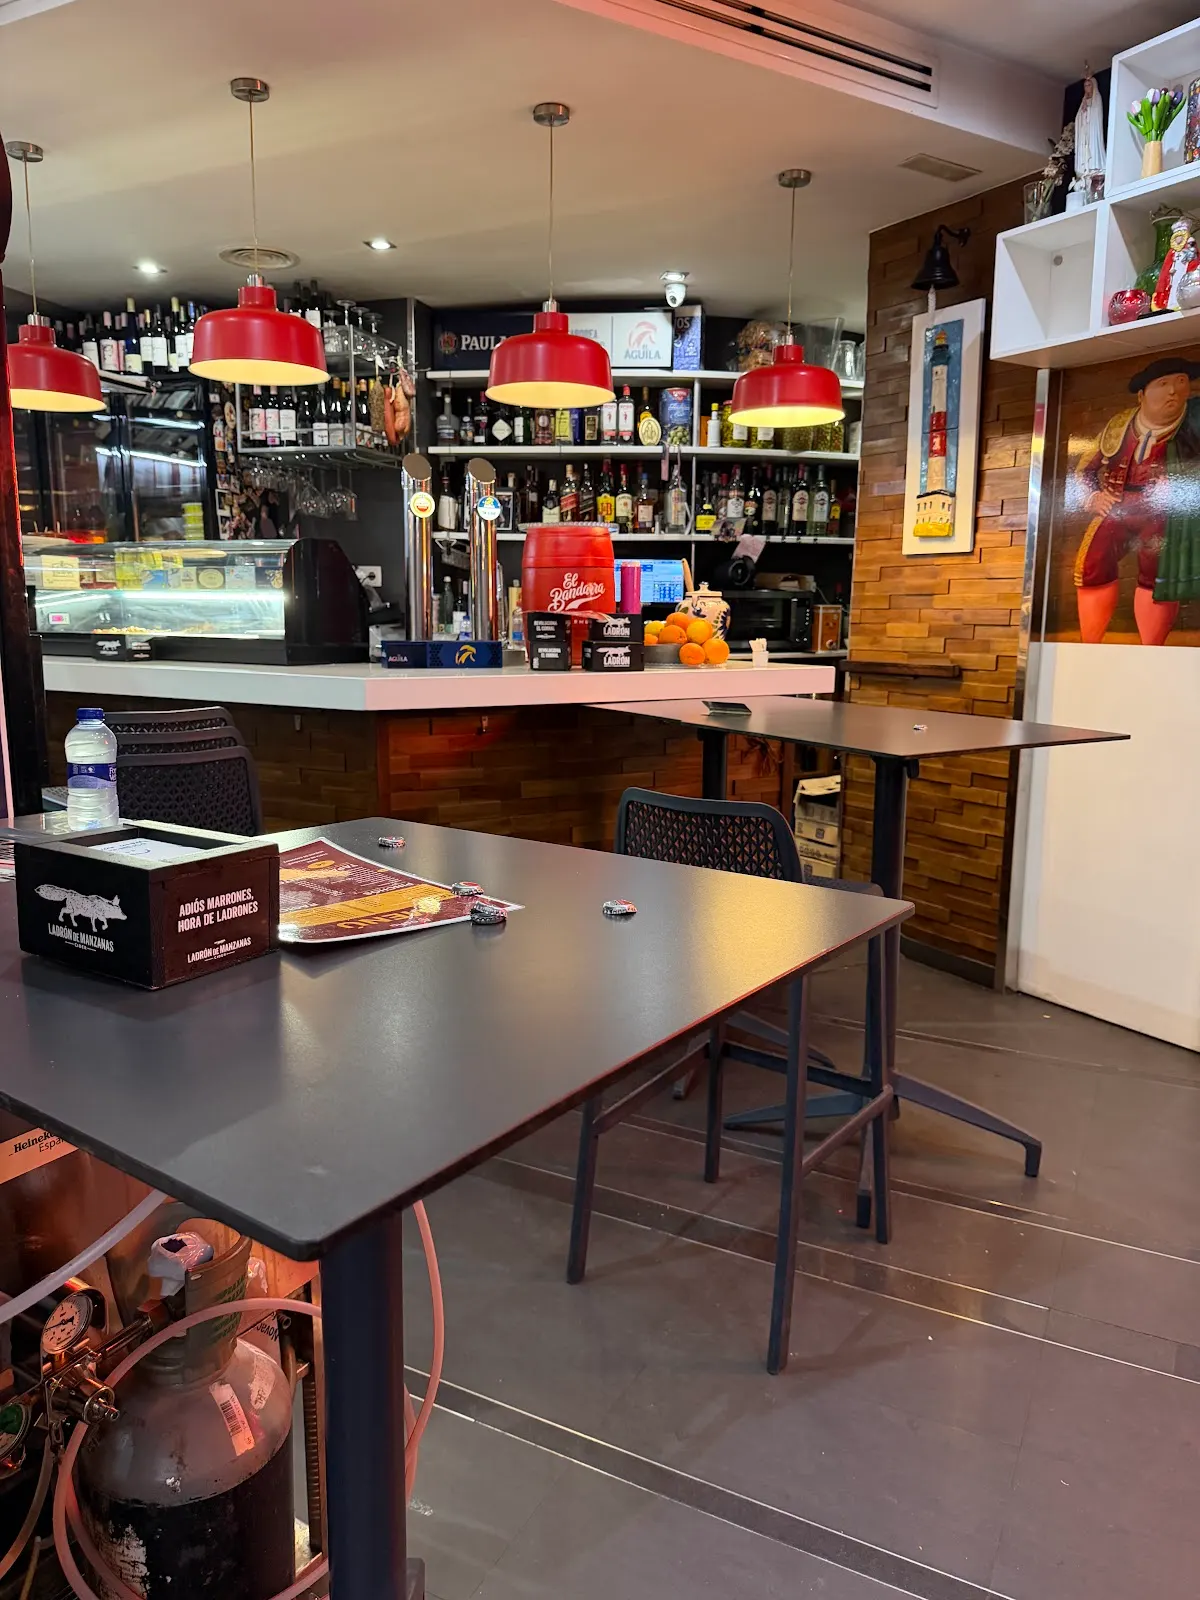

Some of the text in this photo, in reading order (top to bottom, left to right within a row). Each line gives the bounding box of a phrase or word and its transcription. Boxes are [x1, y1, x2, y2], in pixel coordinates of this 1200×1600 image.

[563, 572, 578, 589] El
[548, 582, 605, 612] Bandarra
[177, 915, 201, 933] HORA
[203, 912, 214, 926] DE
[216, 901, 259, 922] LADRONES
[179, 898, 205, 917] ADIÓS
[207, 888, 254, 910] MARRONES,
[48, 922, 114, 952] LADRÓN DE MANZANAS
[187, 937, 251, 963] LADRÓN DE MANZANAS
